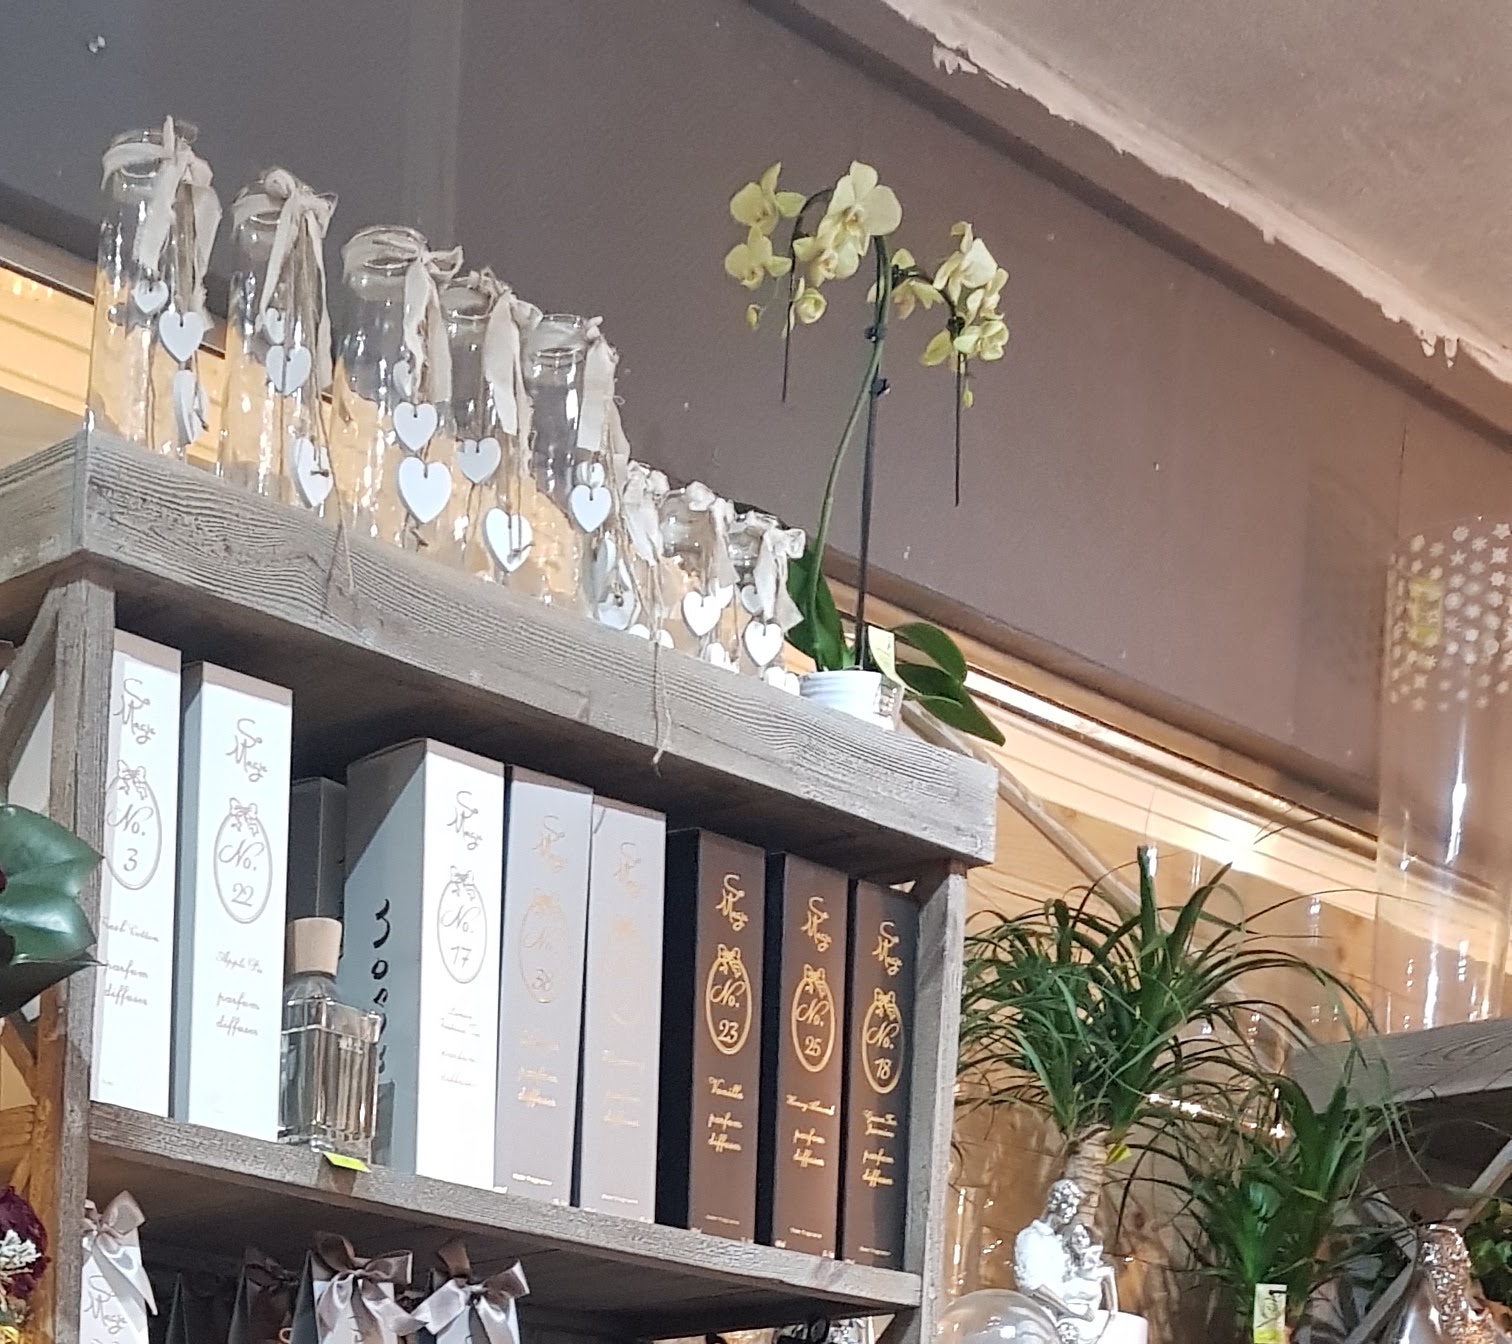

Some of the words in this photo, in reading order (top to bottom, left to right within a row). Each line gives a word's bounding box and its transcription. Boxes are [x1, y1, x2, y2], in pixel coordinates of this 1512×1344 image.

[106, 803, 154, 837] No.
[123, 848, 138, 872] 3
[218, 839, 265, 871] No.
[231, 882, 255, 907] 22
[440, 904, 482, 934] No.
[449, 945, 473, 969] 17
[710, 979, 746, 1008] No.
[795, 998, 830, 1028] No.
[717, 1019, 740, 1044] 23
[866, 1021, 900, 1050] No.
[803, 1035, 823, 1057] 25
[874, 1057, 893, 1080] 18
[707, 1076, 745, 1100] Vanilla
